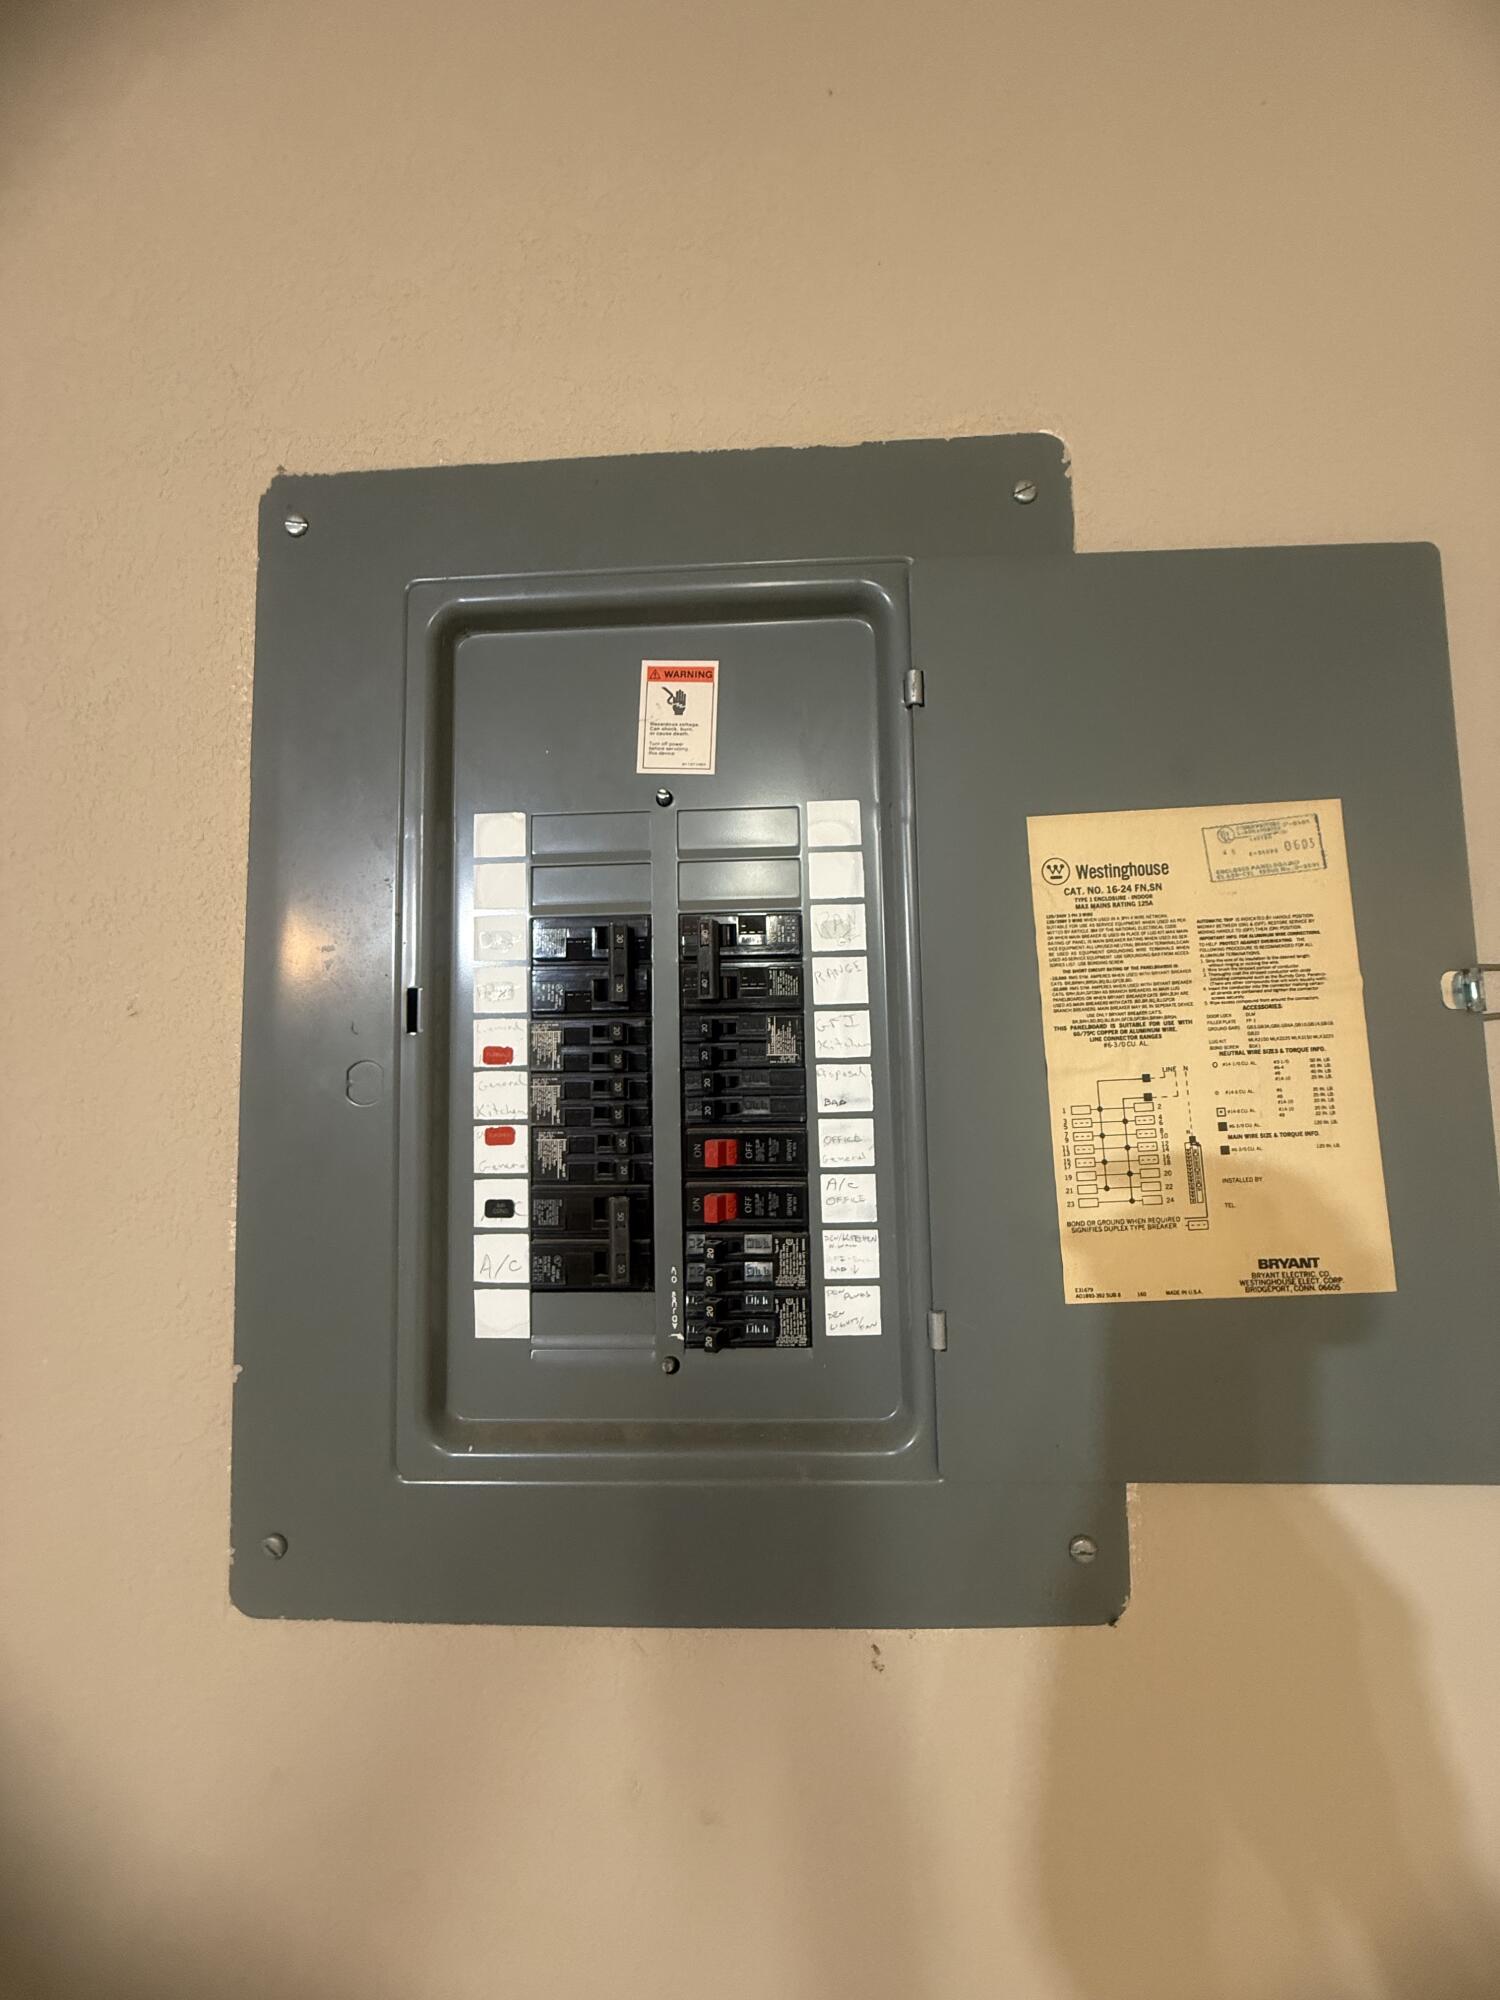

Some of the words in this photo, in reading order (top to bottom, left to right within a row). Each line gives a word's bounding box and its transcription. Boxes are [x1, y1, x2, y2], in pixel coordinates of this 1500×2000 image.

[664, 670, 713, 679] WARNING
[1076, 862, 1169, 880] Westinghouse
[1064, 887, 1085, 896] CAT.
[1088, 886, 1104, 895] NO.
[1107, 885, 1132, 894] 16-24
[616, 934, 624, 944] 30
[616, 984, 623, 992] 30
[613, 1026, 621, 1035] 20
[701, 1023, 708, 1033] 20
[614, 1054, 622, 1064] 20
[701, 1051, 708, 1060] 20
[615, 1082, 622, 1092] 20
[703, 1078, 710, 1088] 20
[615, 1110, 622, 1119] 20
[704, 1106, 712, 1115] 20
[619, 1138, 626, 1148] 20
[694, 1143, 702, 1158] ON
[620, 1166, 628, 1175] 20
[692, 1197, 700, 1212] ON
[617, 1212, 624, 1222] 50
[706, 1248, 714, 1259] 20
[1258, 1257, 1320, 1270] BRYANT
[617, 1264, 625, 1274] 50
[706, 1276, 713, 1287] 20
[1239, 1278, 1294, 1286] WESTINGHOUSE
[706, 1306, 714, 1318] 20
[705, 1336, 713, 1347] 20
